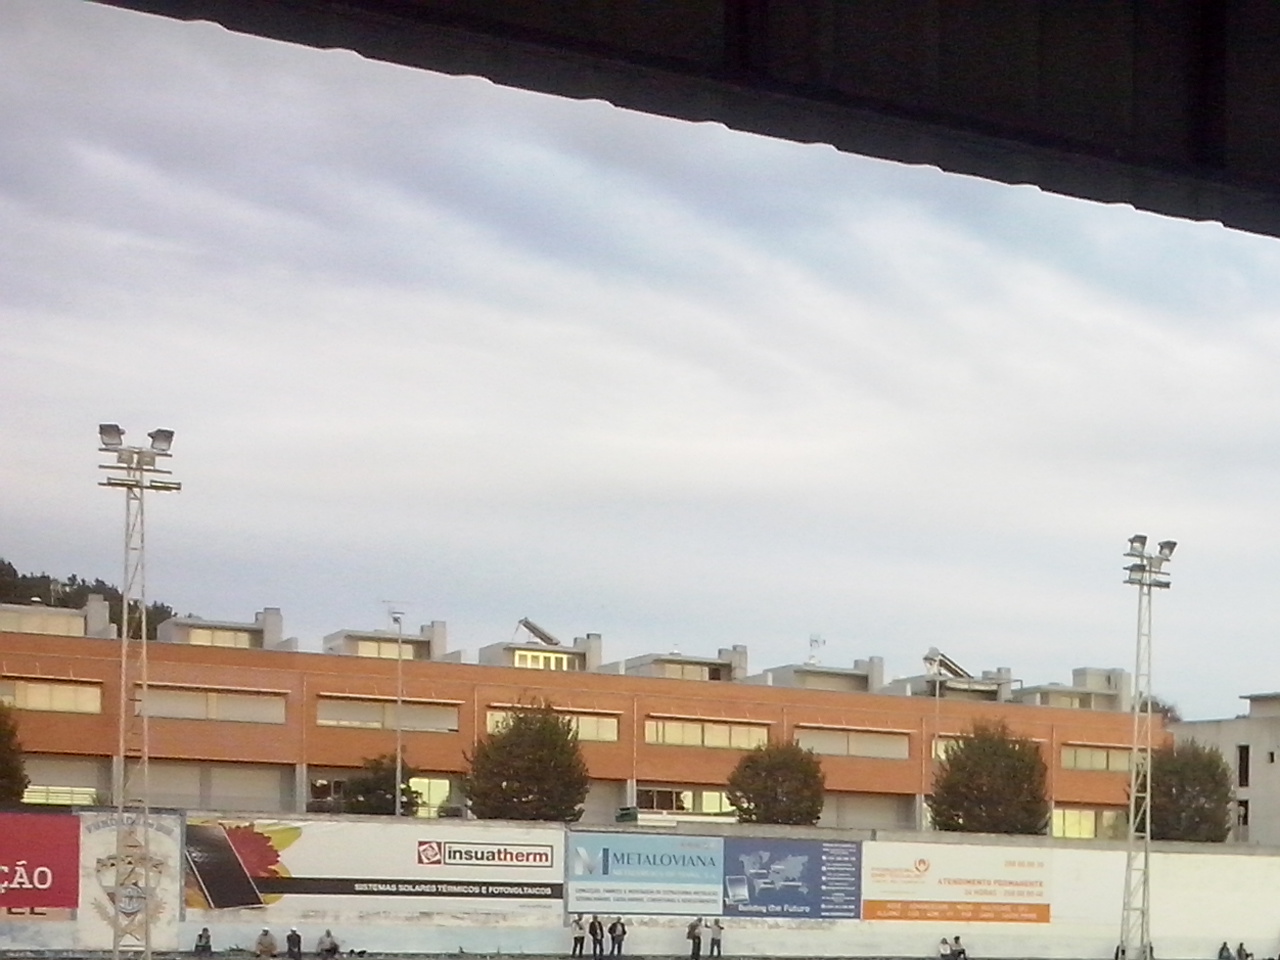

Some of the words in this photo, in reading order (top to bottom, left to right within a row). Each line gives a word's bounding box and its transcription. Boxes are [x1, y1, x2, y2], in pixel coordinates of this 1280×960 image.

[447, 846, 549, 863] insuatherm
[612, 852, 717, 867] METALOVIANA
[354, 883, 397, 892] SISTEMAS
[398, 883, 437, 893] SOLARES
[481, 885, 488, 895] E
